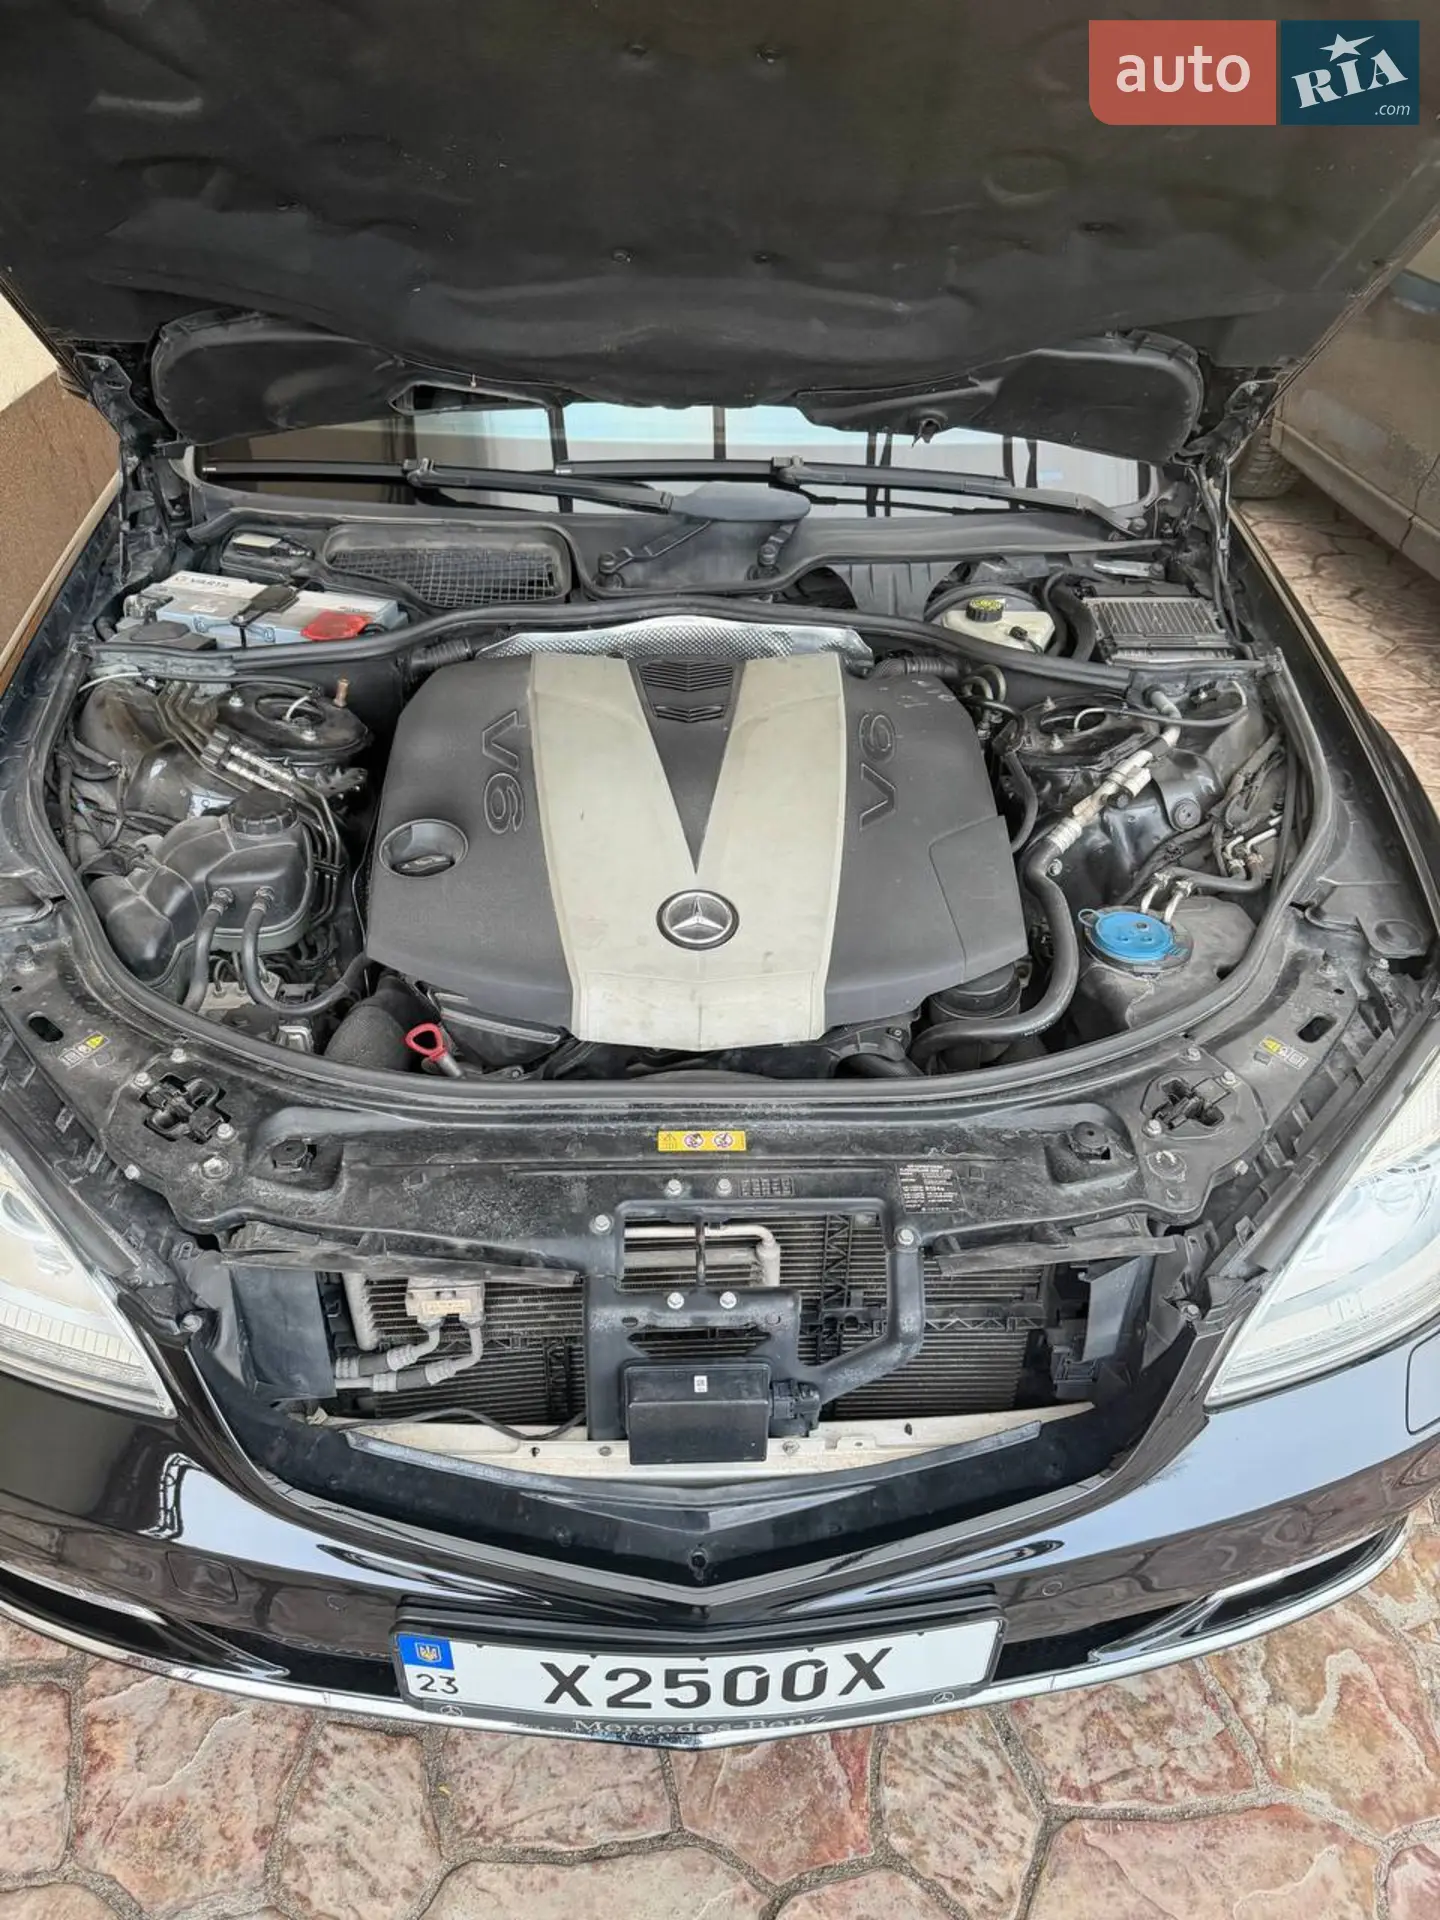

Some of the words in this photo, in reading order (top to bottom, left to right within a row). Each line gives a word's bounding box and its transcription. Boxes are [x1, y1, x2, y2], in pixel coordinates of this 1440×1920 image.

[481, 709, 526, 834] V6
[859, 712, 896, 831] V6
[416, 1673, 459, 1694] 23
[540, 1647, 893, 1709] X2500X
[572, 1715, 826, 1733] Mercedes-Benz
